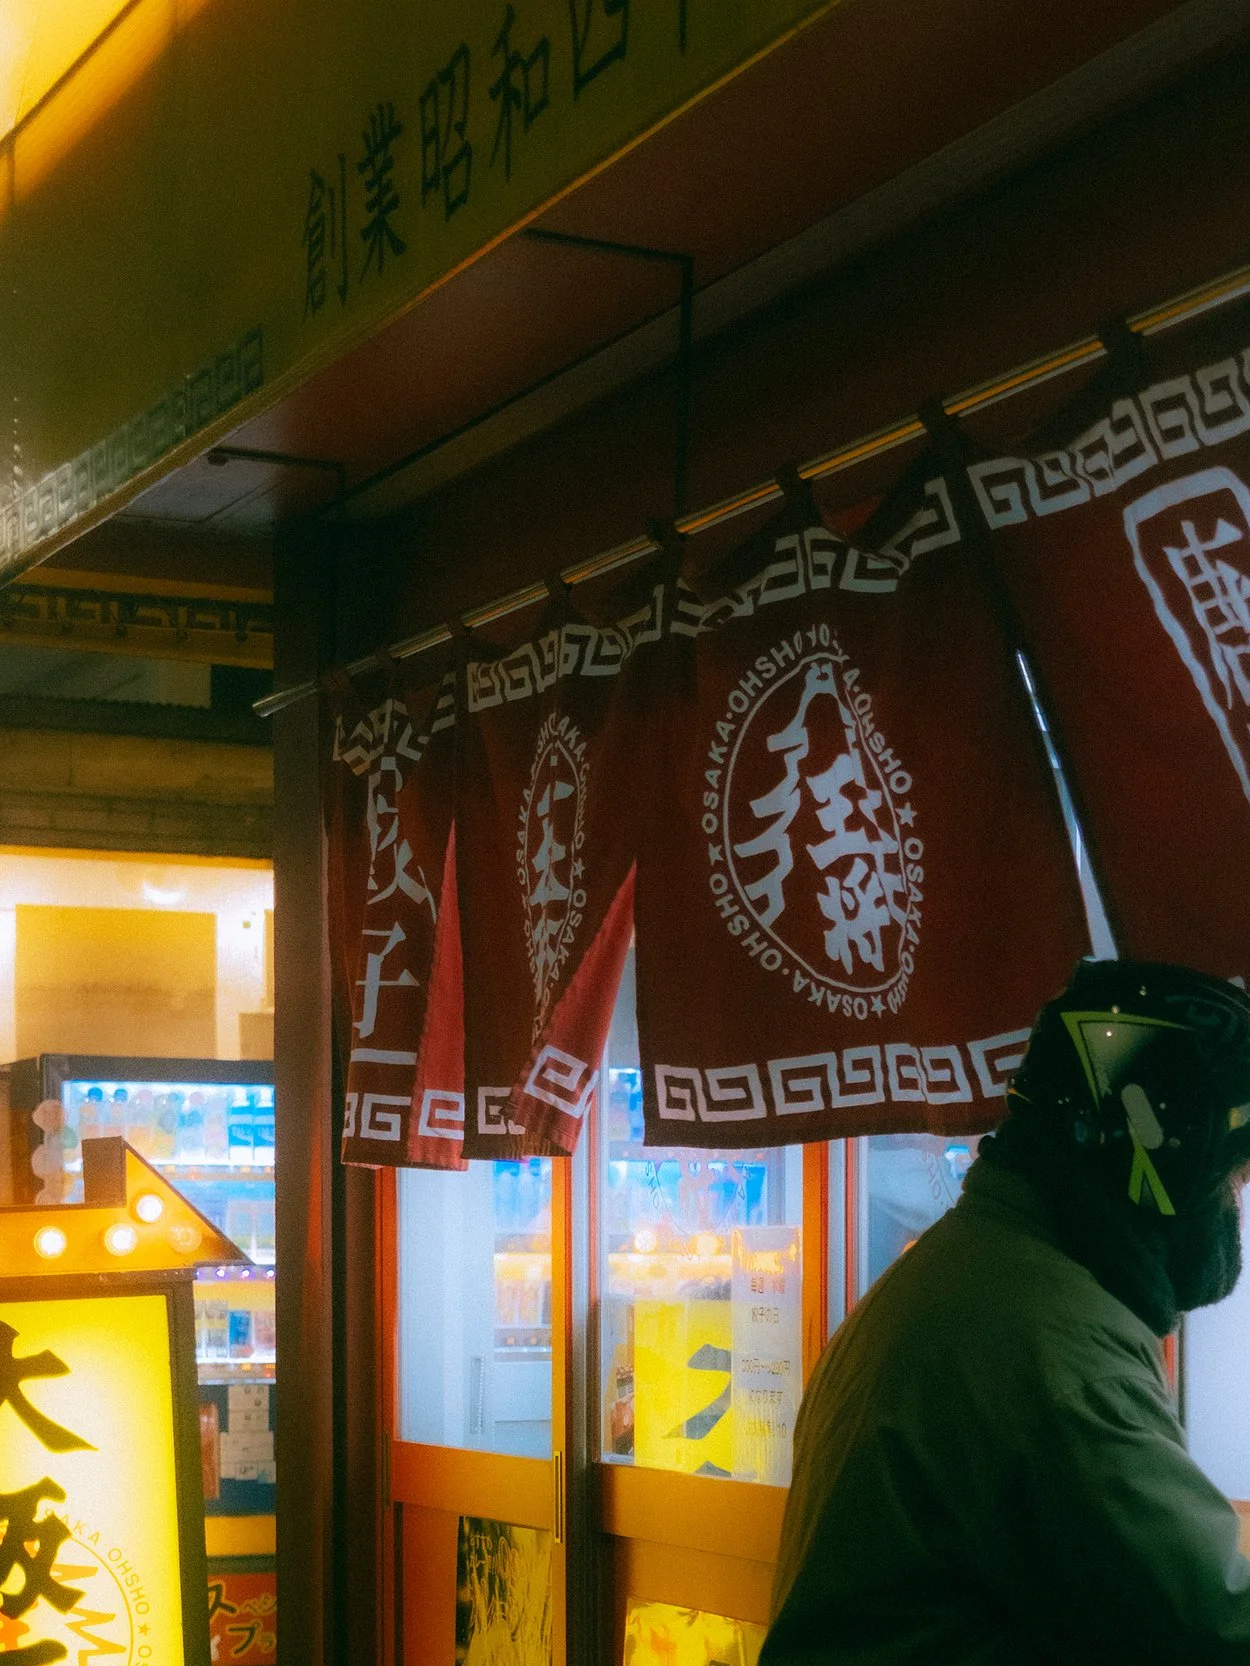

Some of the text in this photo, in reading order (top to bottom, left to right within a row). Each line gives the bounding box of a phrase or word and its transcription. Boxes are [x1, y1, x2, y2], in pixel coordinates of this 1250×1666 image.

[302, 0, 688, 320] 創業昭和四
